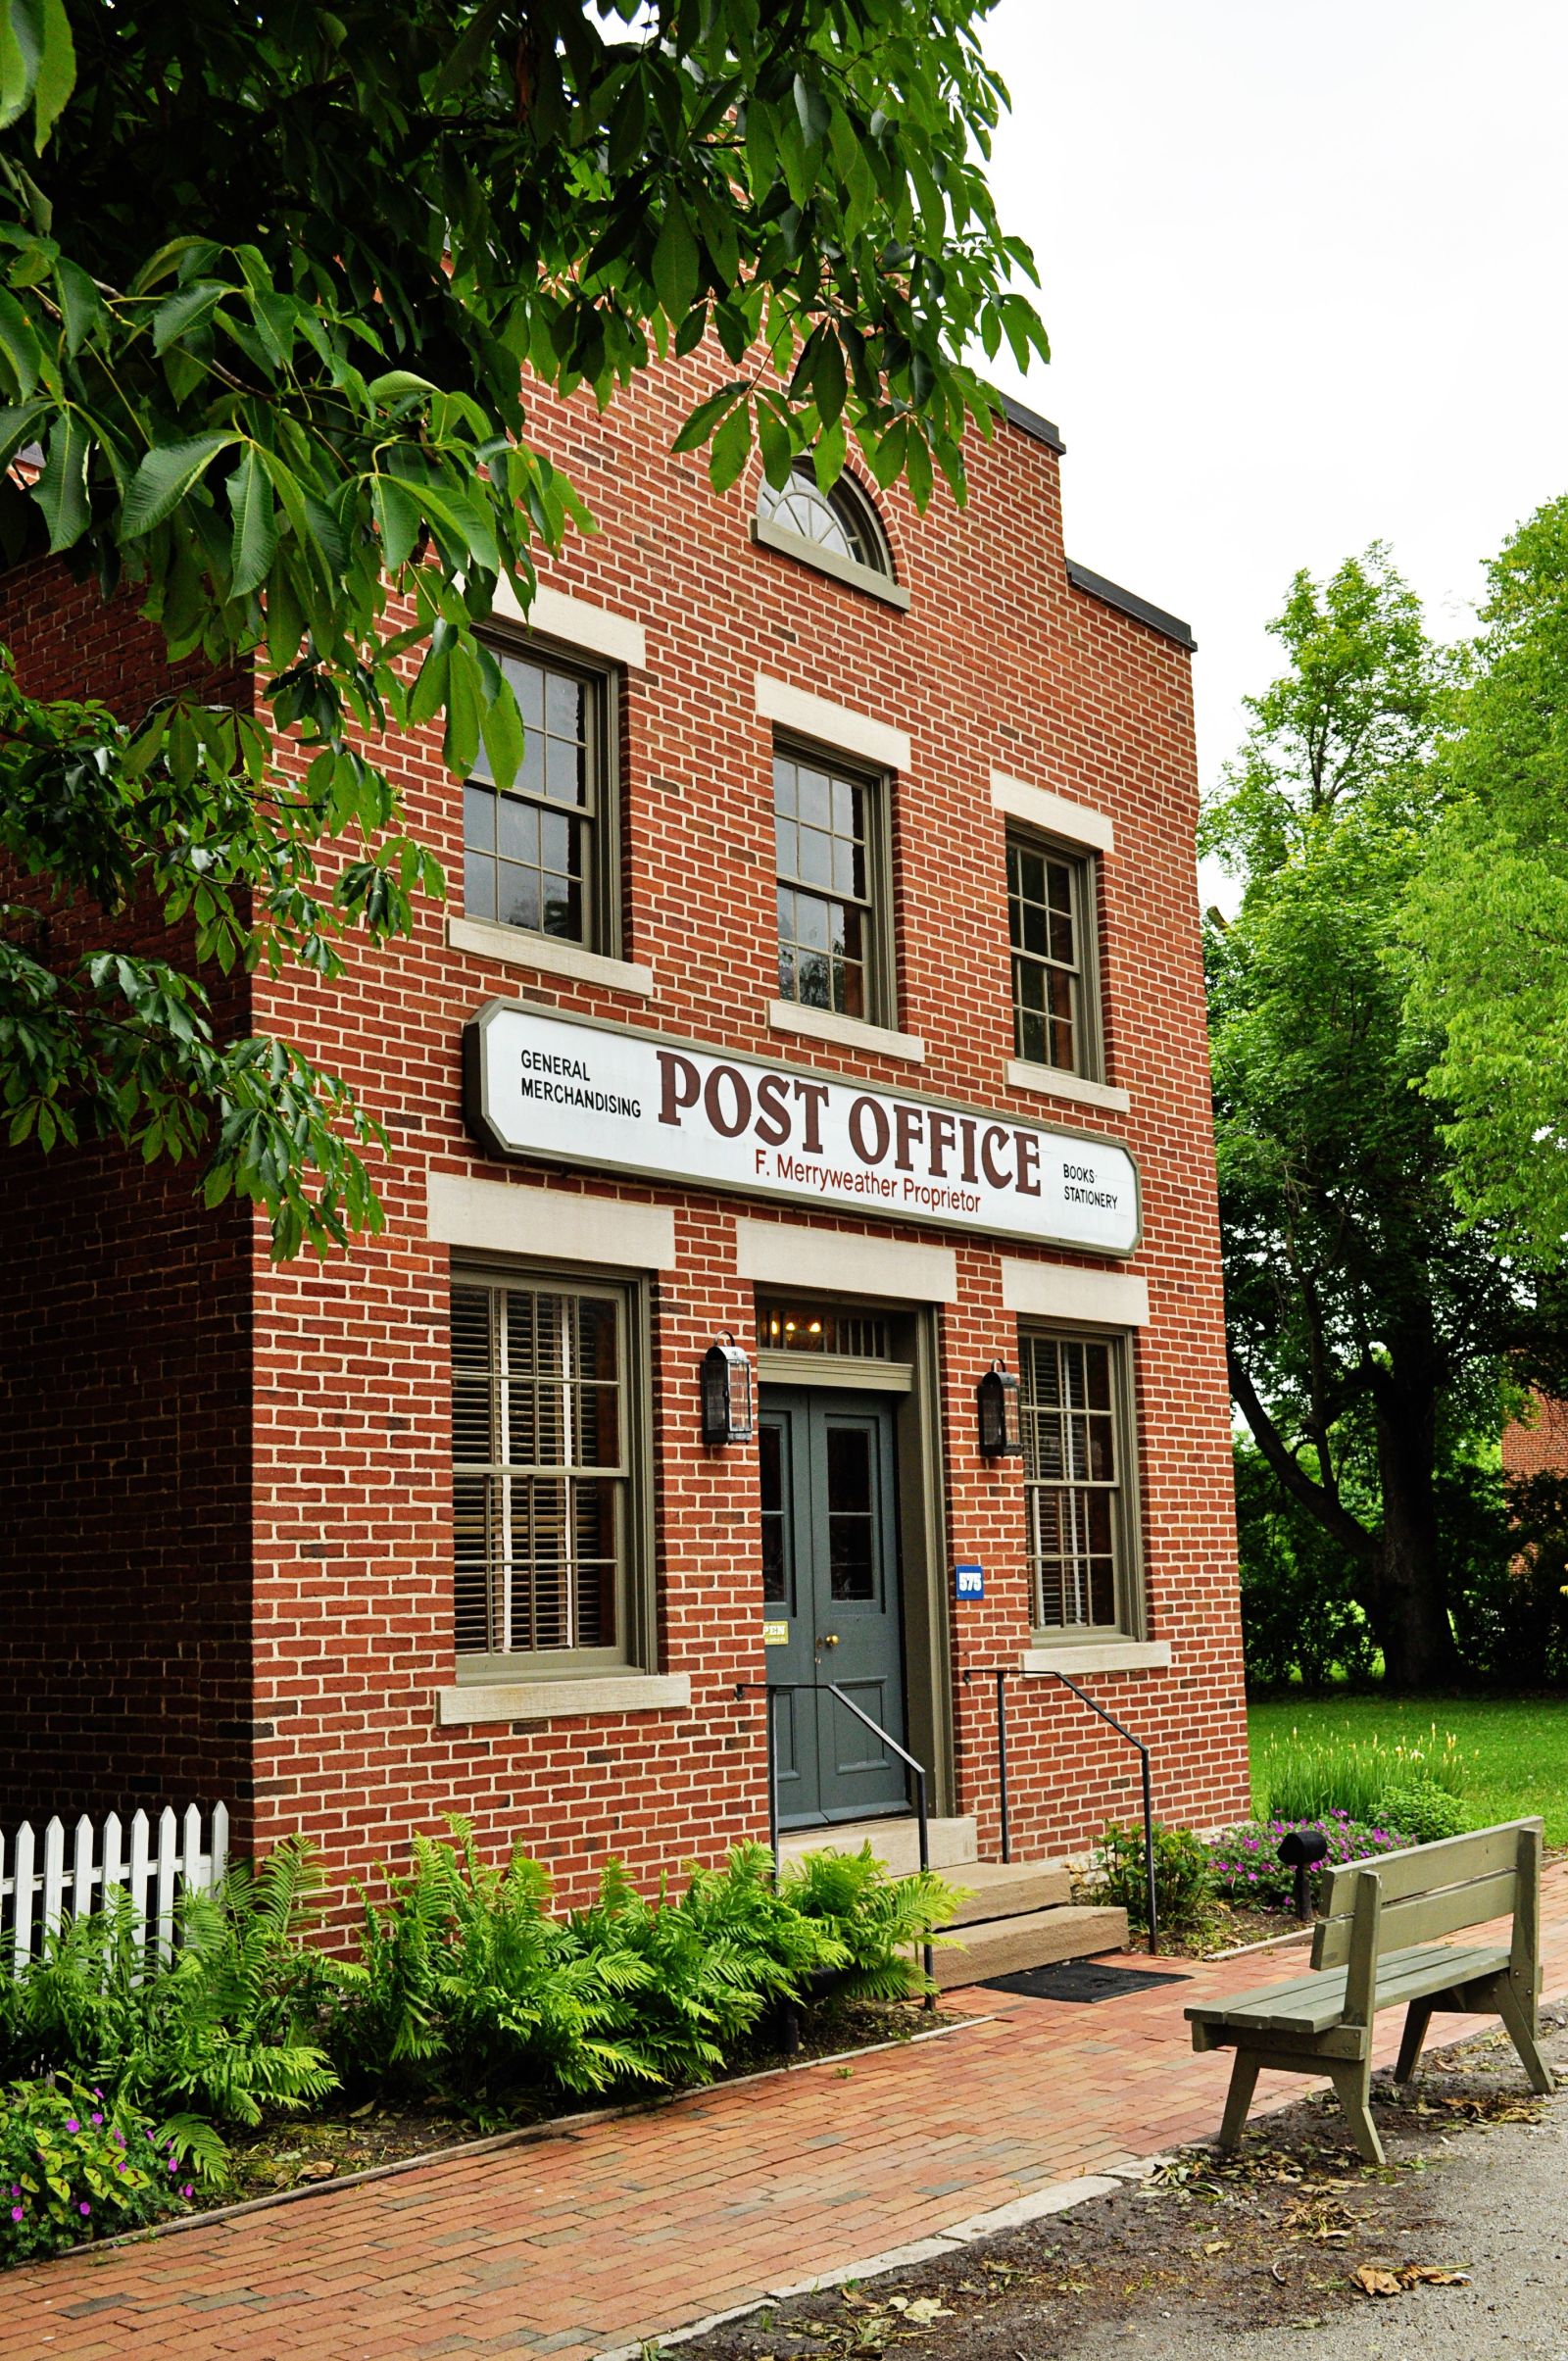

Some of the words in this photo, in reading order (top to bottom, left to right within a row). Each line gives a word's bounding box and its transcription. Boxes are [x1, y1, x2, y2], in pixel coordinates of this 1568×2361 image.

[521, 1050, 590, 1081] GENERAL
[521, 1078, 641, 1118] MERCHANDISING
[656, 1050, 829, 1155] POST
[849, 1096, 1042, 1197] OFFICE
[756, 1149, 770, 1176] F.
[777, 1154, 898, 1198] Merryweather
[904, 1177, 981, 1211] Proprietor
[1063, 1163, 1095, 1184] BOOKS
[1064, 1186, 1118, 1209] STATIONERY
[958, 1572, 982, 1592] 575
[763, 1625, 785, 1636] PEN
